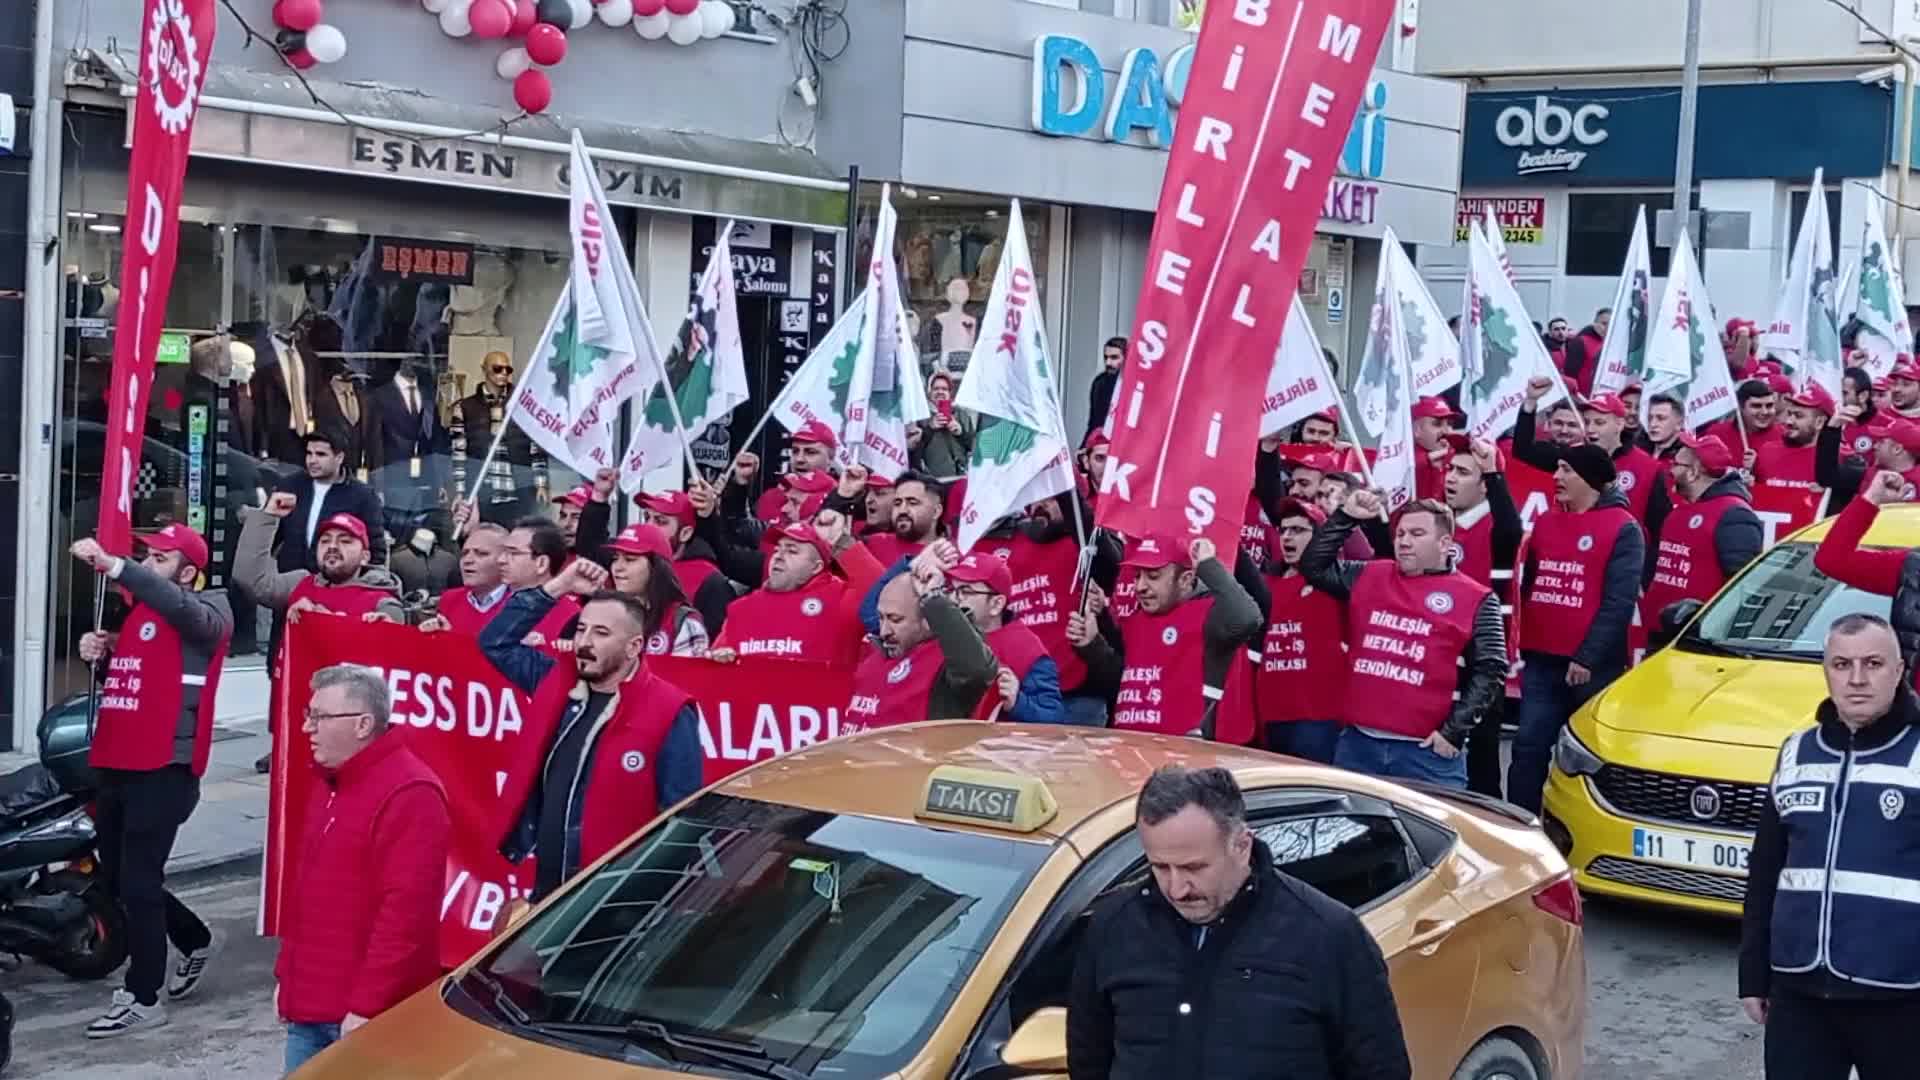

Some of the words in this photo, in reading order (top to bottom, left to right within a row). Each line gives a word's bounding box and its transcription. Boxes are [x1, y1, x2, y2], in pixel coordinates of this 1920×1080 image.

[1496, 95, 1609, 147] abc
[354, 137, 515, 179] EŞMEN
[1231, 14, 1362, 329] METAL
[1517, 148, 1588, 171] bedding
[1322, 181, 1379, 224] KET
[381, 245, 469, 280] EŞMEN
[702, 246, 777, 277] aya
[1100, 0, 1272, 502] BİRLEŞİK
[814, 250, 834, 324] Kaya
[1184, 411, 1223, 534] İŞ
[1368, 610, 1433, 637] BİRLEŞİK
[739, 635, 803, 656] BİRLEŞİK
[1265, 658, 1308, 672] DİKASI
[1353, 658, 1425, 686] SENDİKASI
[382, 666, 457, 732] ESS
[1647, 834, 1664, 858] 11
[1685, 839, 1696, 863] T
